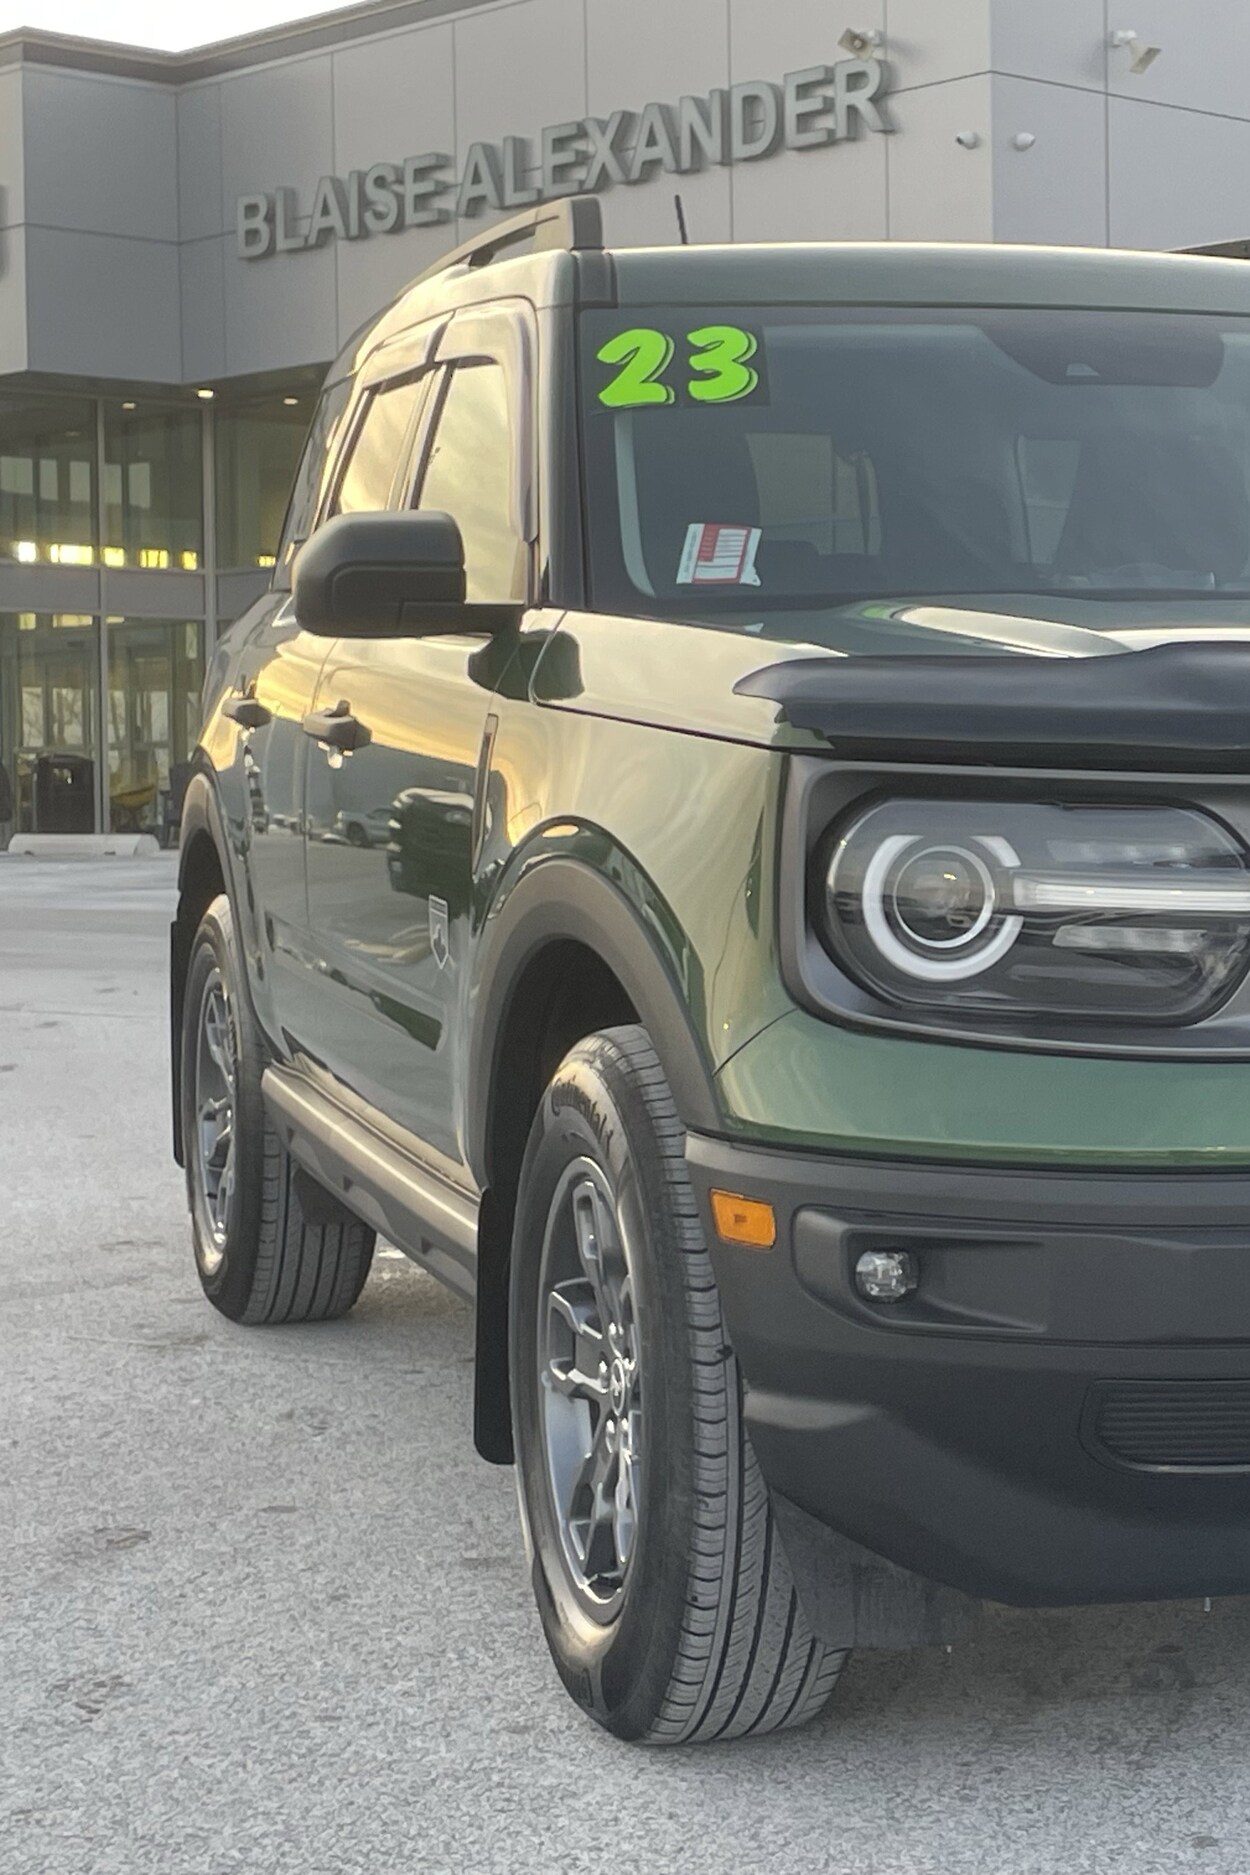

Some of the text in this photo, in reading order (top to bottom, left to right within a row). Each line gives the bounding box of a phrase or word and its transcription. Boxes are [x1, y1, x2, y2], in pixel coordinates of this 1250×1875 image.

[236, 57, 894, 260] BLAISE ALEXANDER
[597, 325, 758, 408] 23
